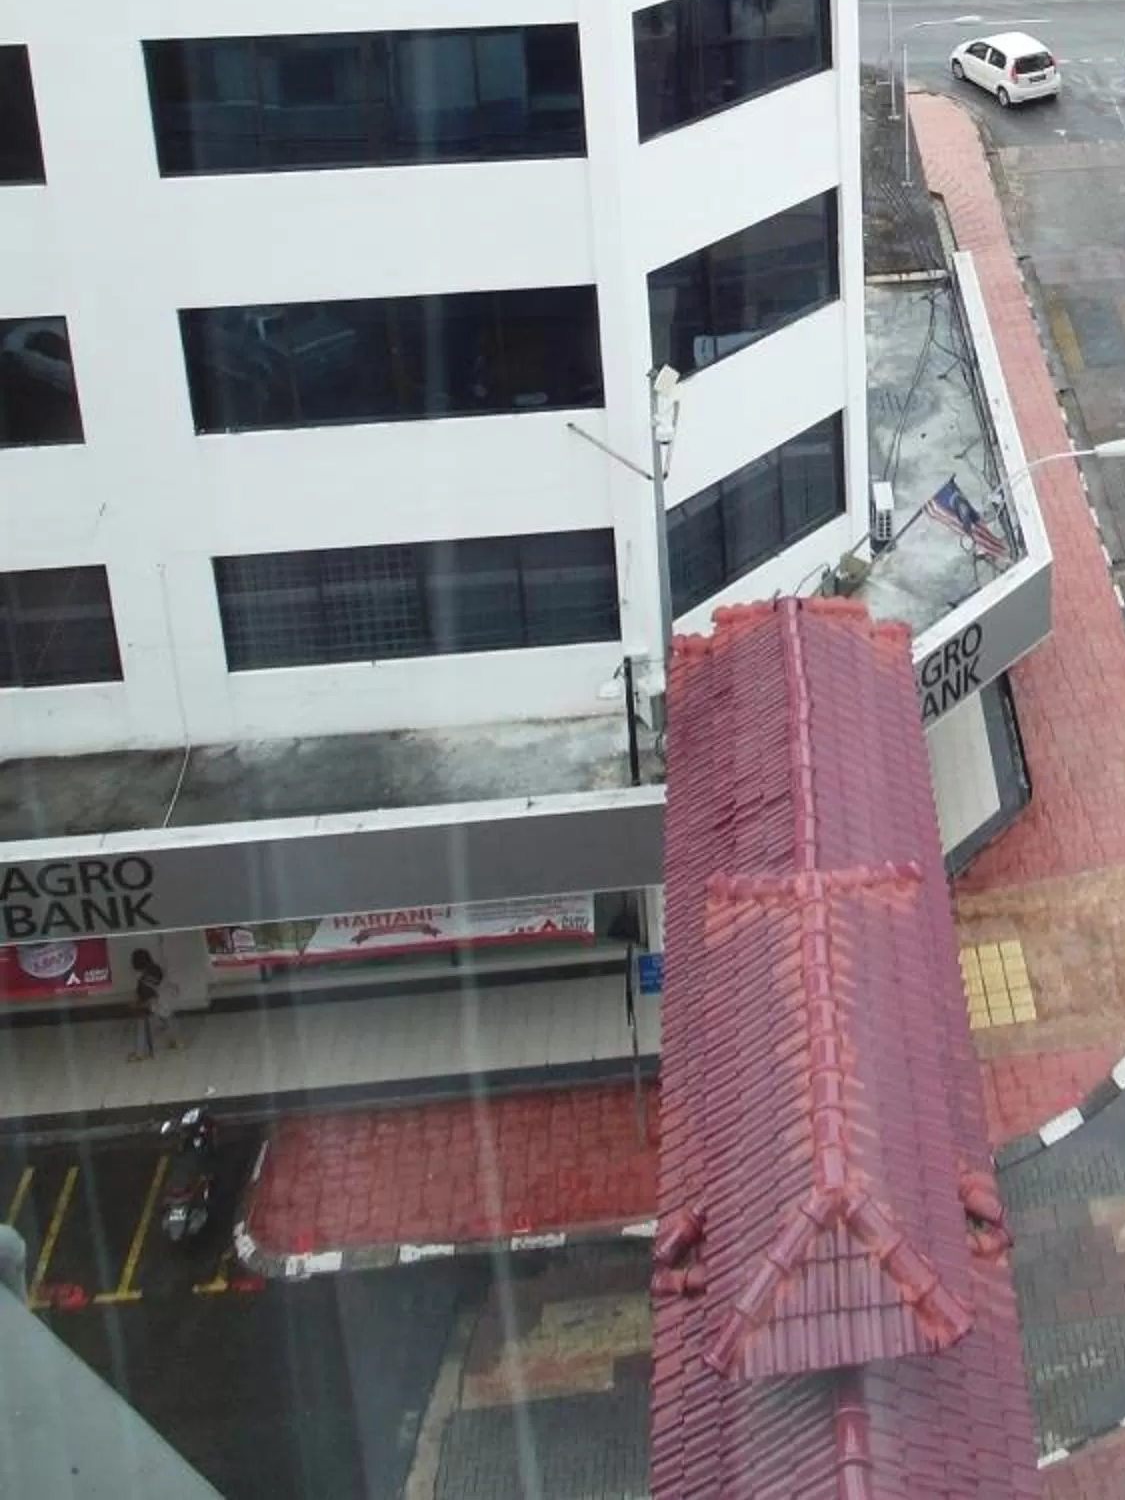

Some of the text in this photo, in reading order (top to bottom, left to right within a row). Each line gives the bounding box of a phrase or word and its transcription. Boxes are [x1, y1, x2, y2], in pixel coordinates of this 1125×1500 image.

[915, 622, 982, 694] GRO
[920, 655, 982, 721] ANK
[0, 856, 153, 900] AGRO
[3, 892, 160, 938] BANK
